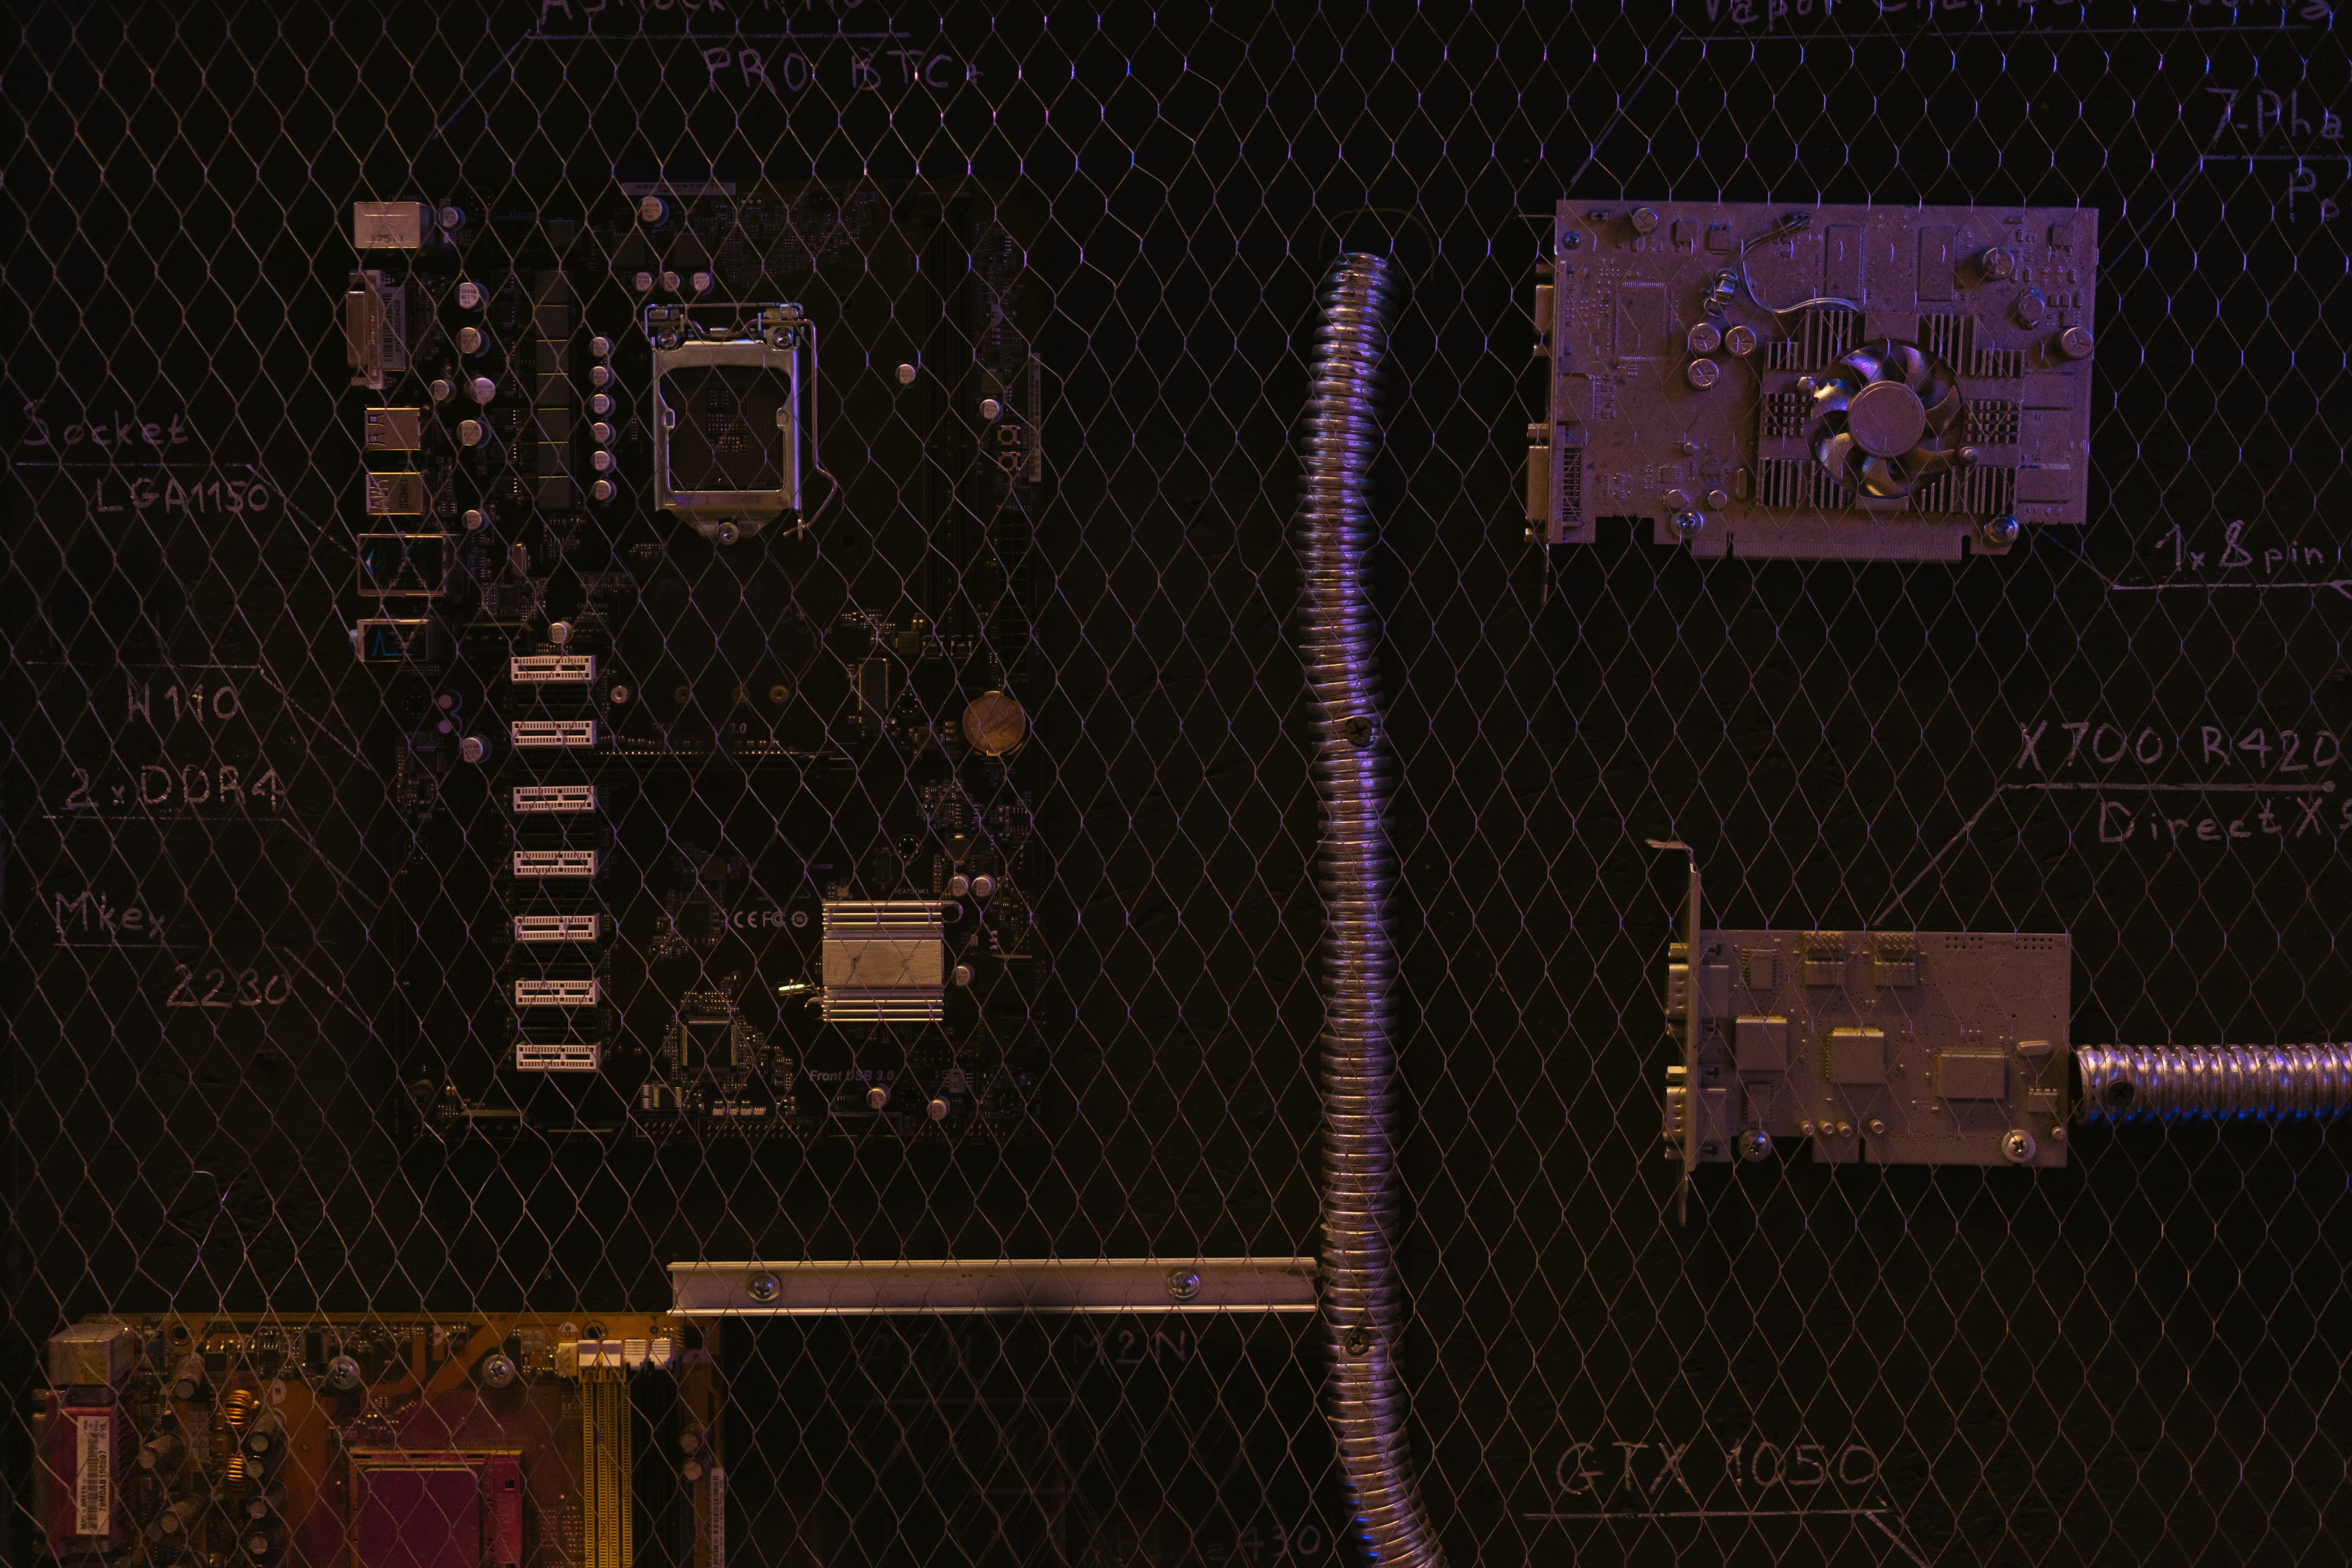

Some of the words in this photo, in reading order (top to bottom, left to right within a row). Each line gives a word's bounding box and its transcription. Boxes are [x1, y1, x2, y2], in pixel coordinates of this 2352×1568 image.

[702, 48, 806, 95] PRO
[23, 400, 188, 447] Socket
[97, 477, 269, 514] LGA1150
[2017, 720, 2163, 770] X700
[2201, 726, 2340, 772] R420
[141, 765, 286, 812] DDR4
[166, 964, 291, 1008] 2230
[809, 1070, 843, 1081] Front
[876, 1070, 894, 1081] 3.0
[1556, 1442, 1689, 1494] GTX
[1726, 1439, 1878, 1488] 1050
